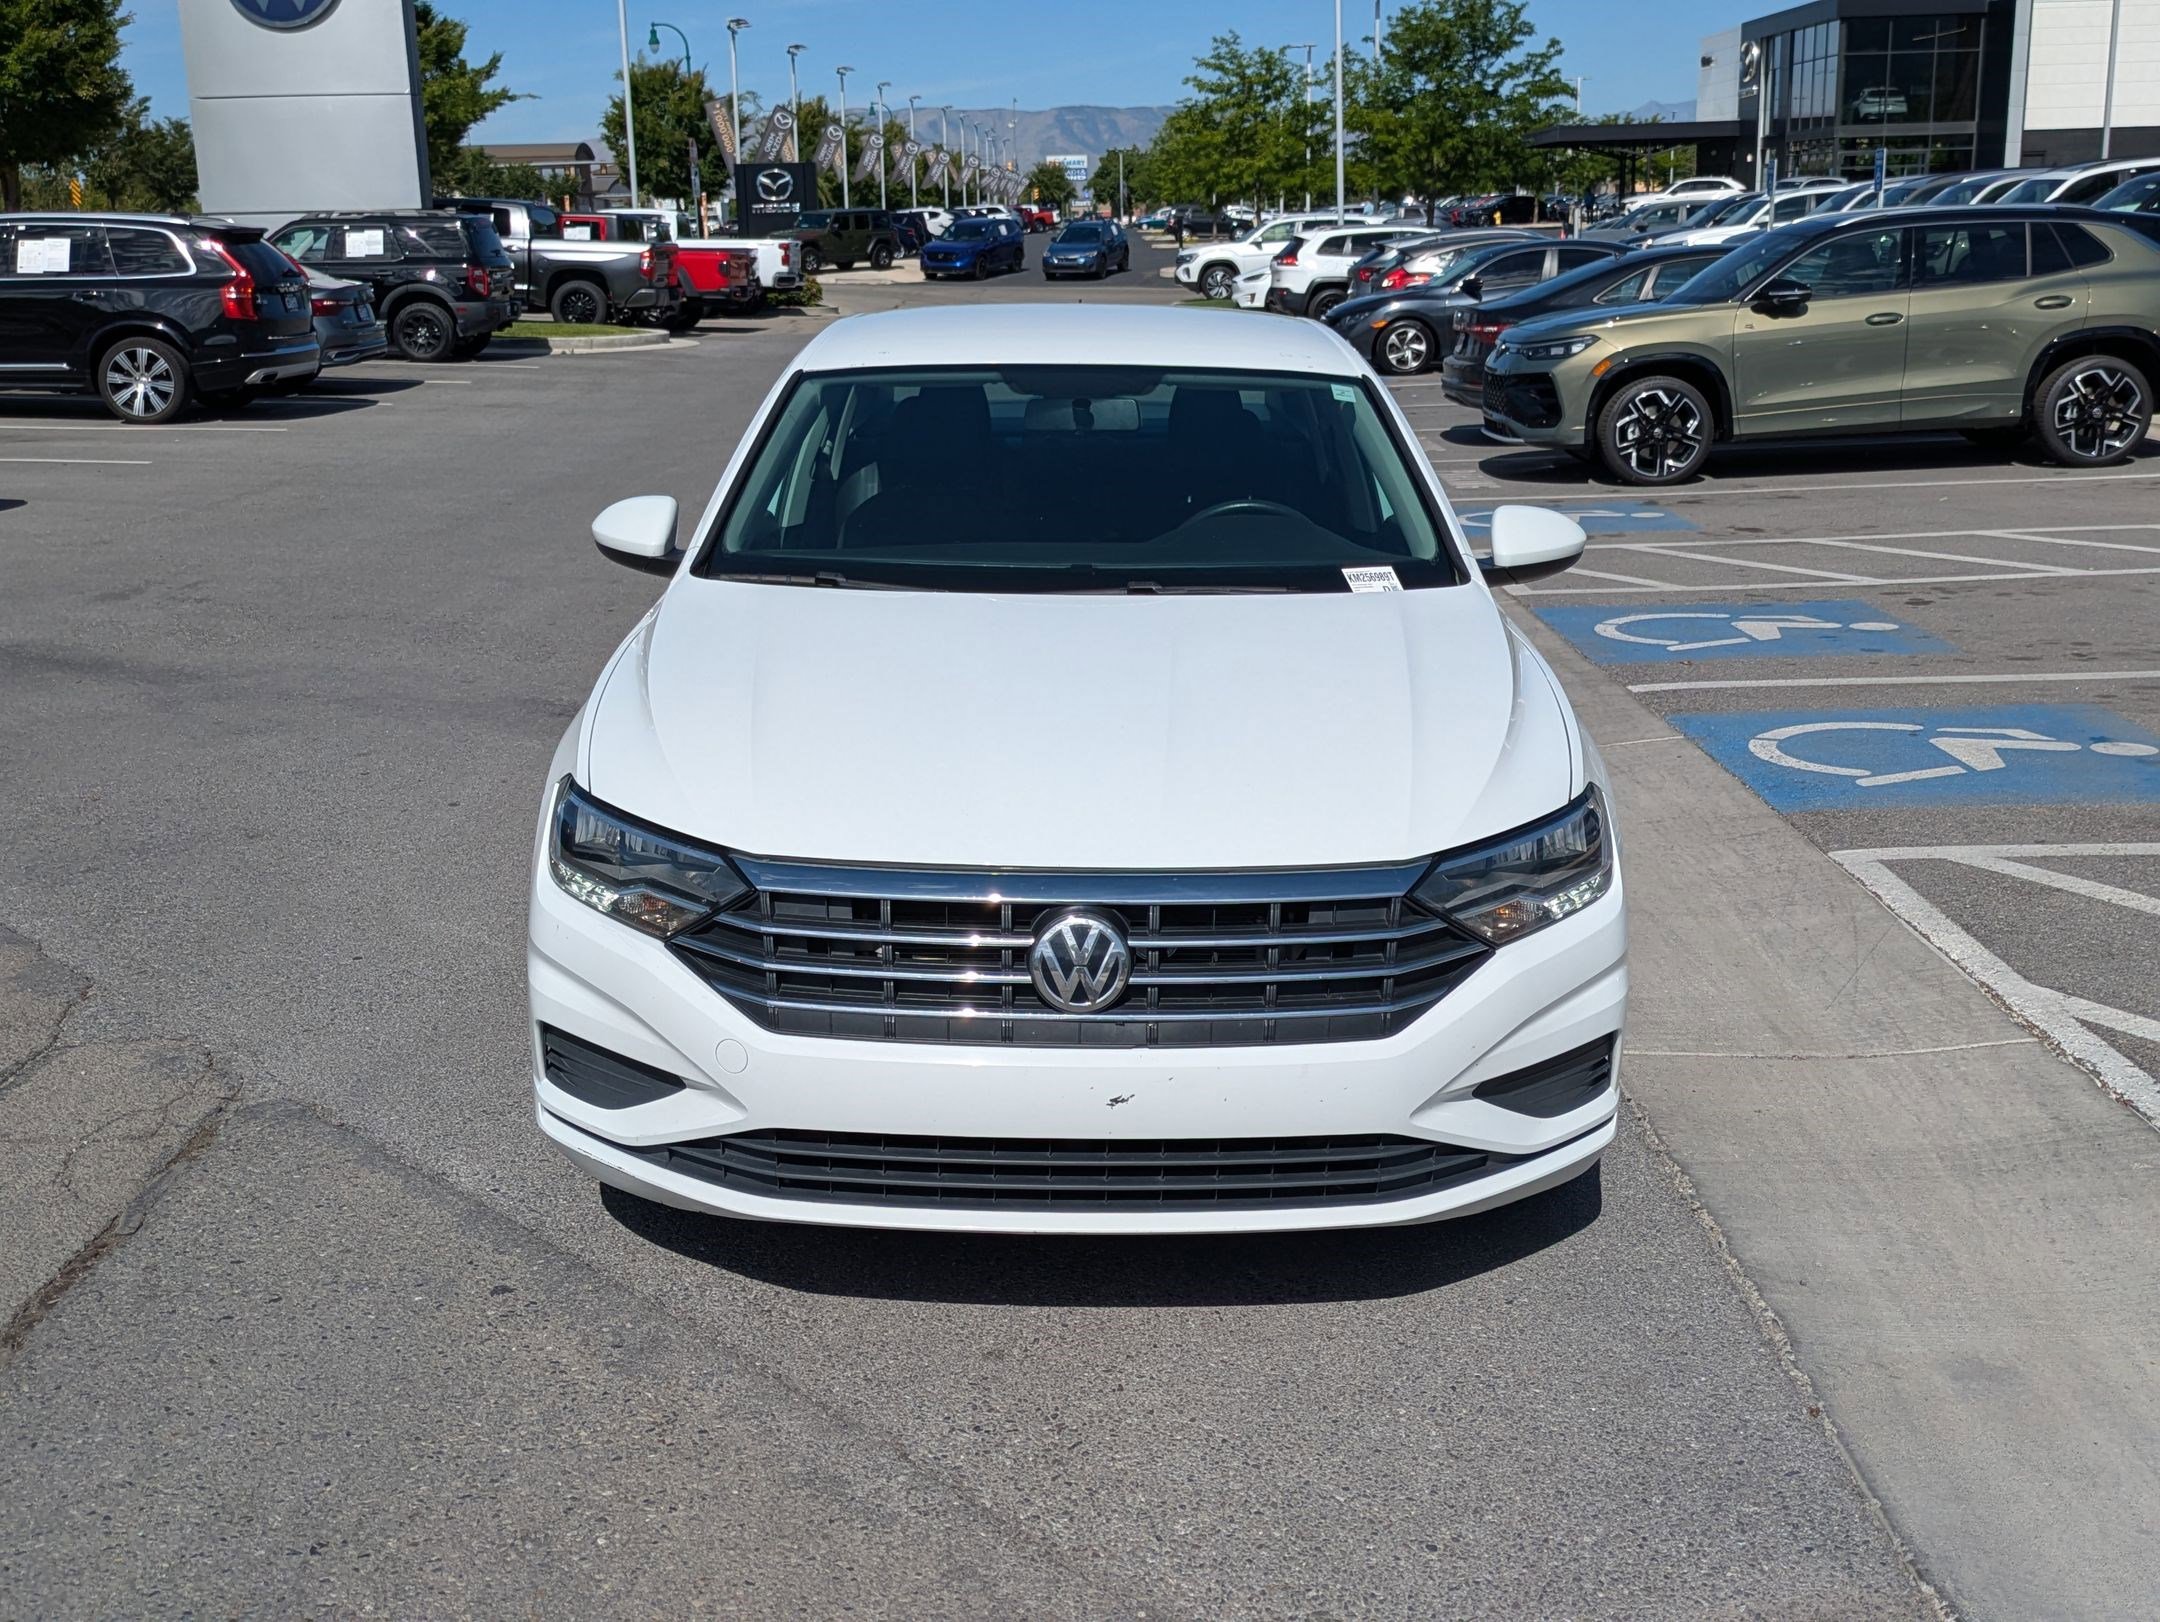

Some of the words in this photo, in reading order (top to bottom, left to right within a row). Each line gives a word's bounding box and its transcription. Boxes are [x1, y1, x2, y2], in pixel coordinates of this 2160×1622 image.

[764, 132, 776, 153] OREM
[768, 132, 785, 161] MAZDA
[822, 142, 837, 168] MAZDA
[1346, 571, 1395, 583] KM256989T
